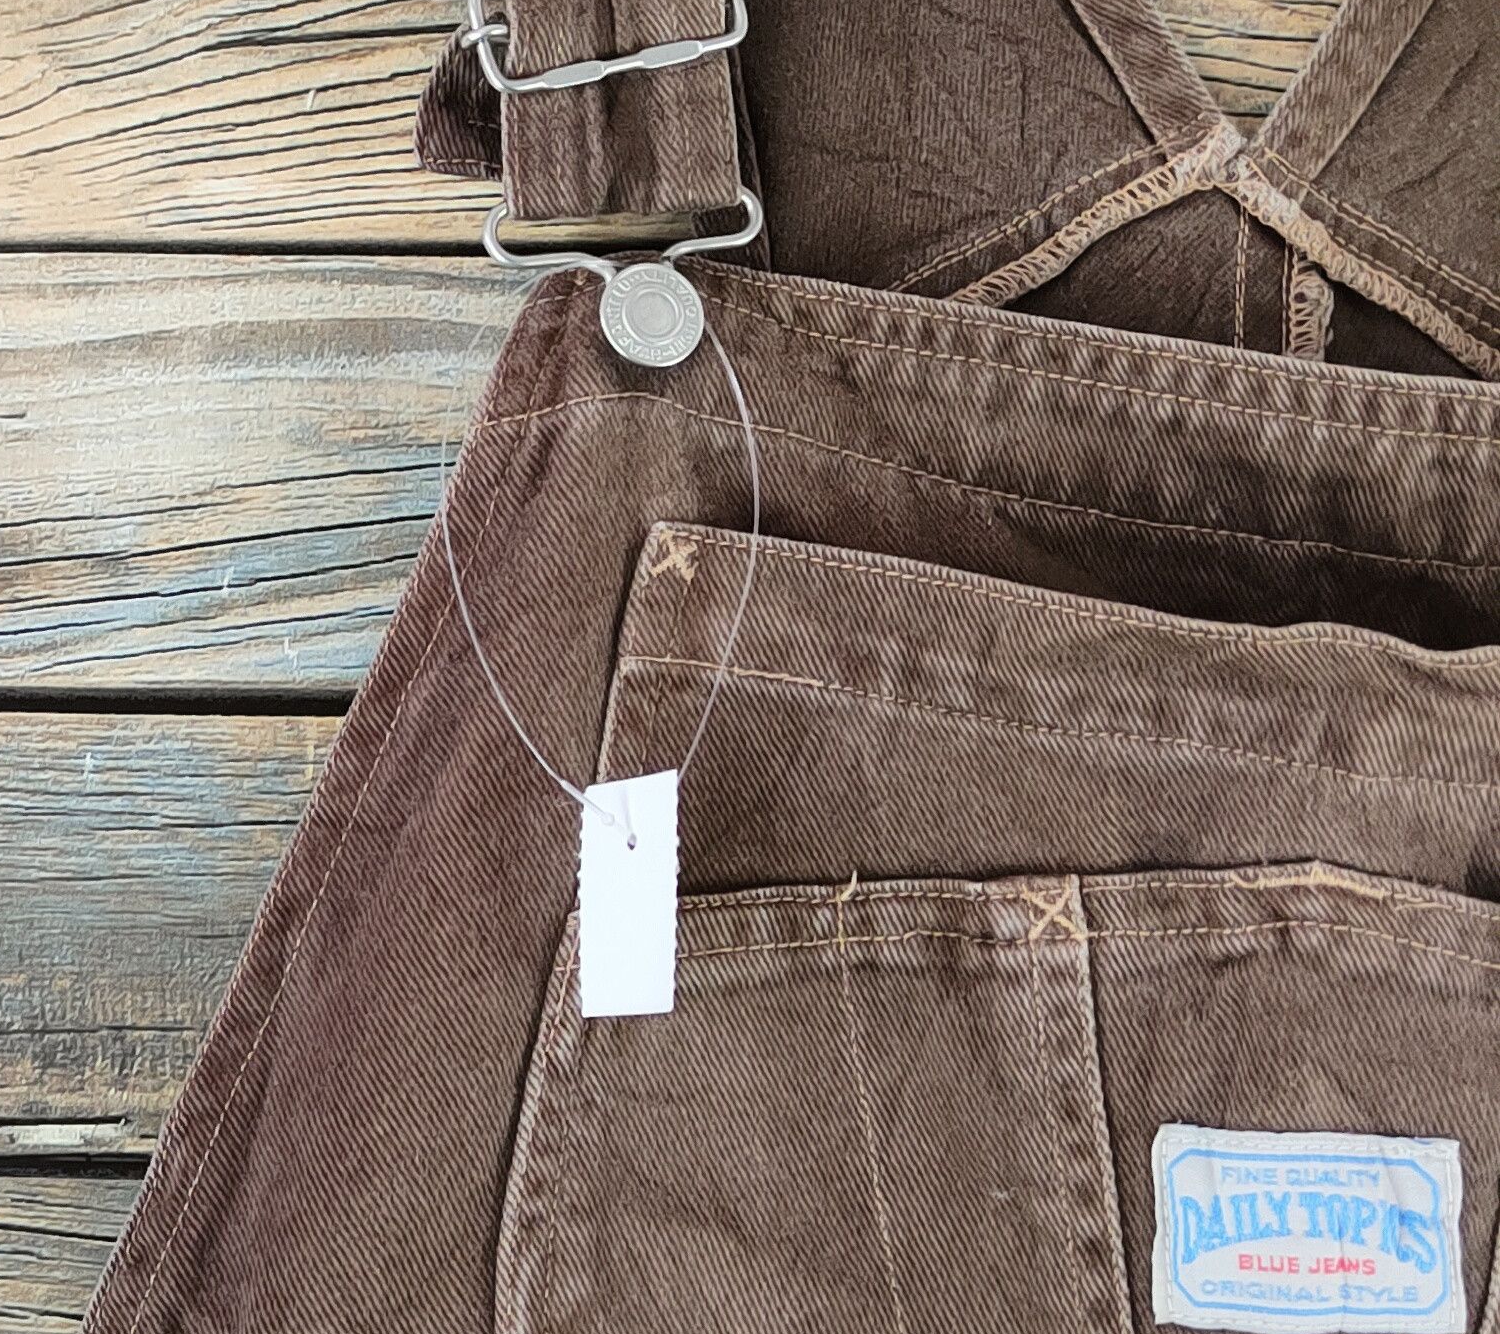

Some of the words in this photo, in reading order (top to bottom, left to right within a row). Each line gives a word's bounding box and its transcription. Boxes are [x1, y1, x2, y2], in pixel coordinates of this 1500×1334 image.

[1221, 1167, 1278, 1186] FINE
[1286, 1169, 1380, 1188] QUALITY
[1179, 1191, 1293, 1265] DAILY
[1238, 1254, 1300, 1274] BLUE
[1308, 1257, 1377, 1276] JEANS
[1200, 1279, 1329, 1302] ORIGINAL
[1339, 1283, 1419, 1303] STYLE
